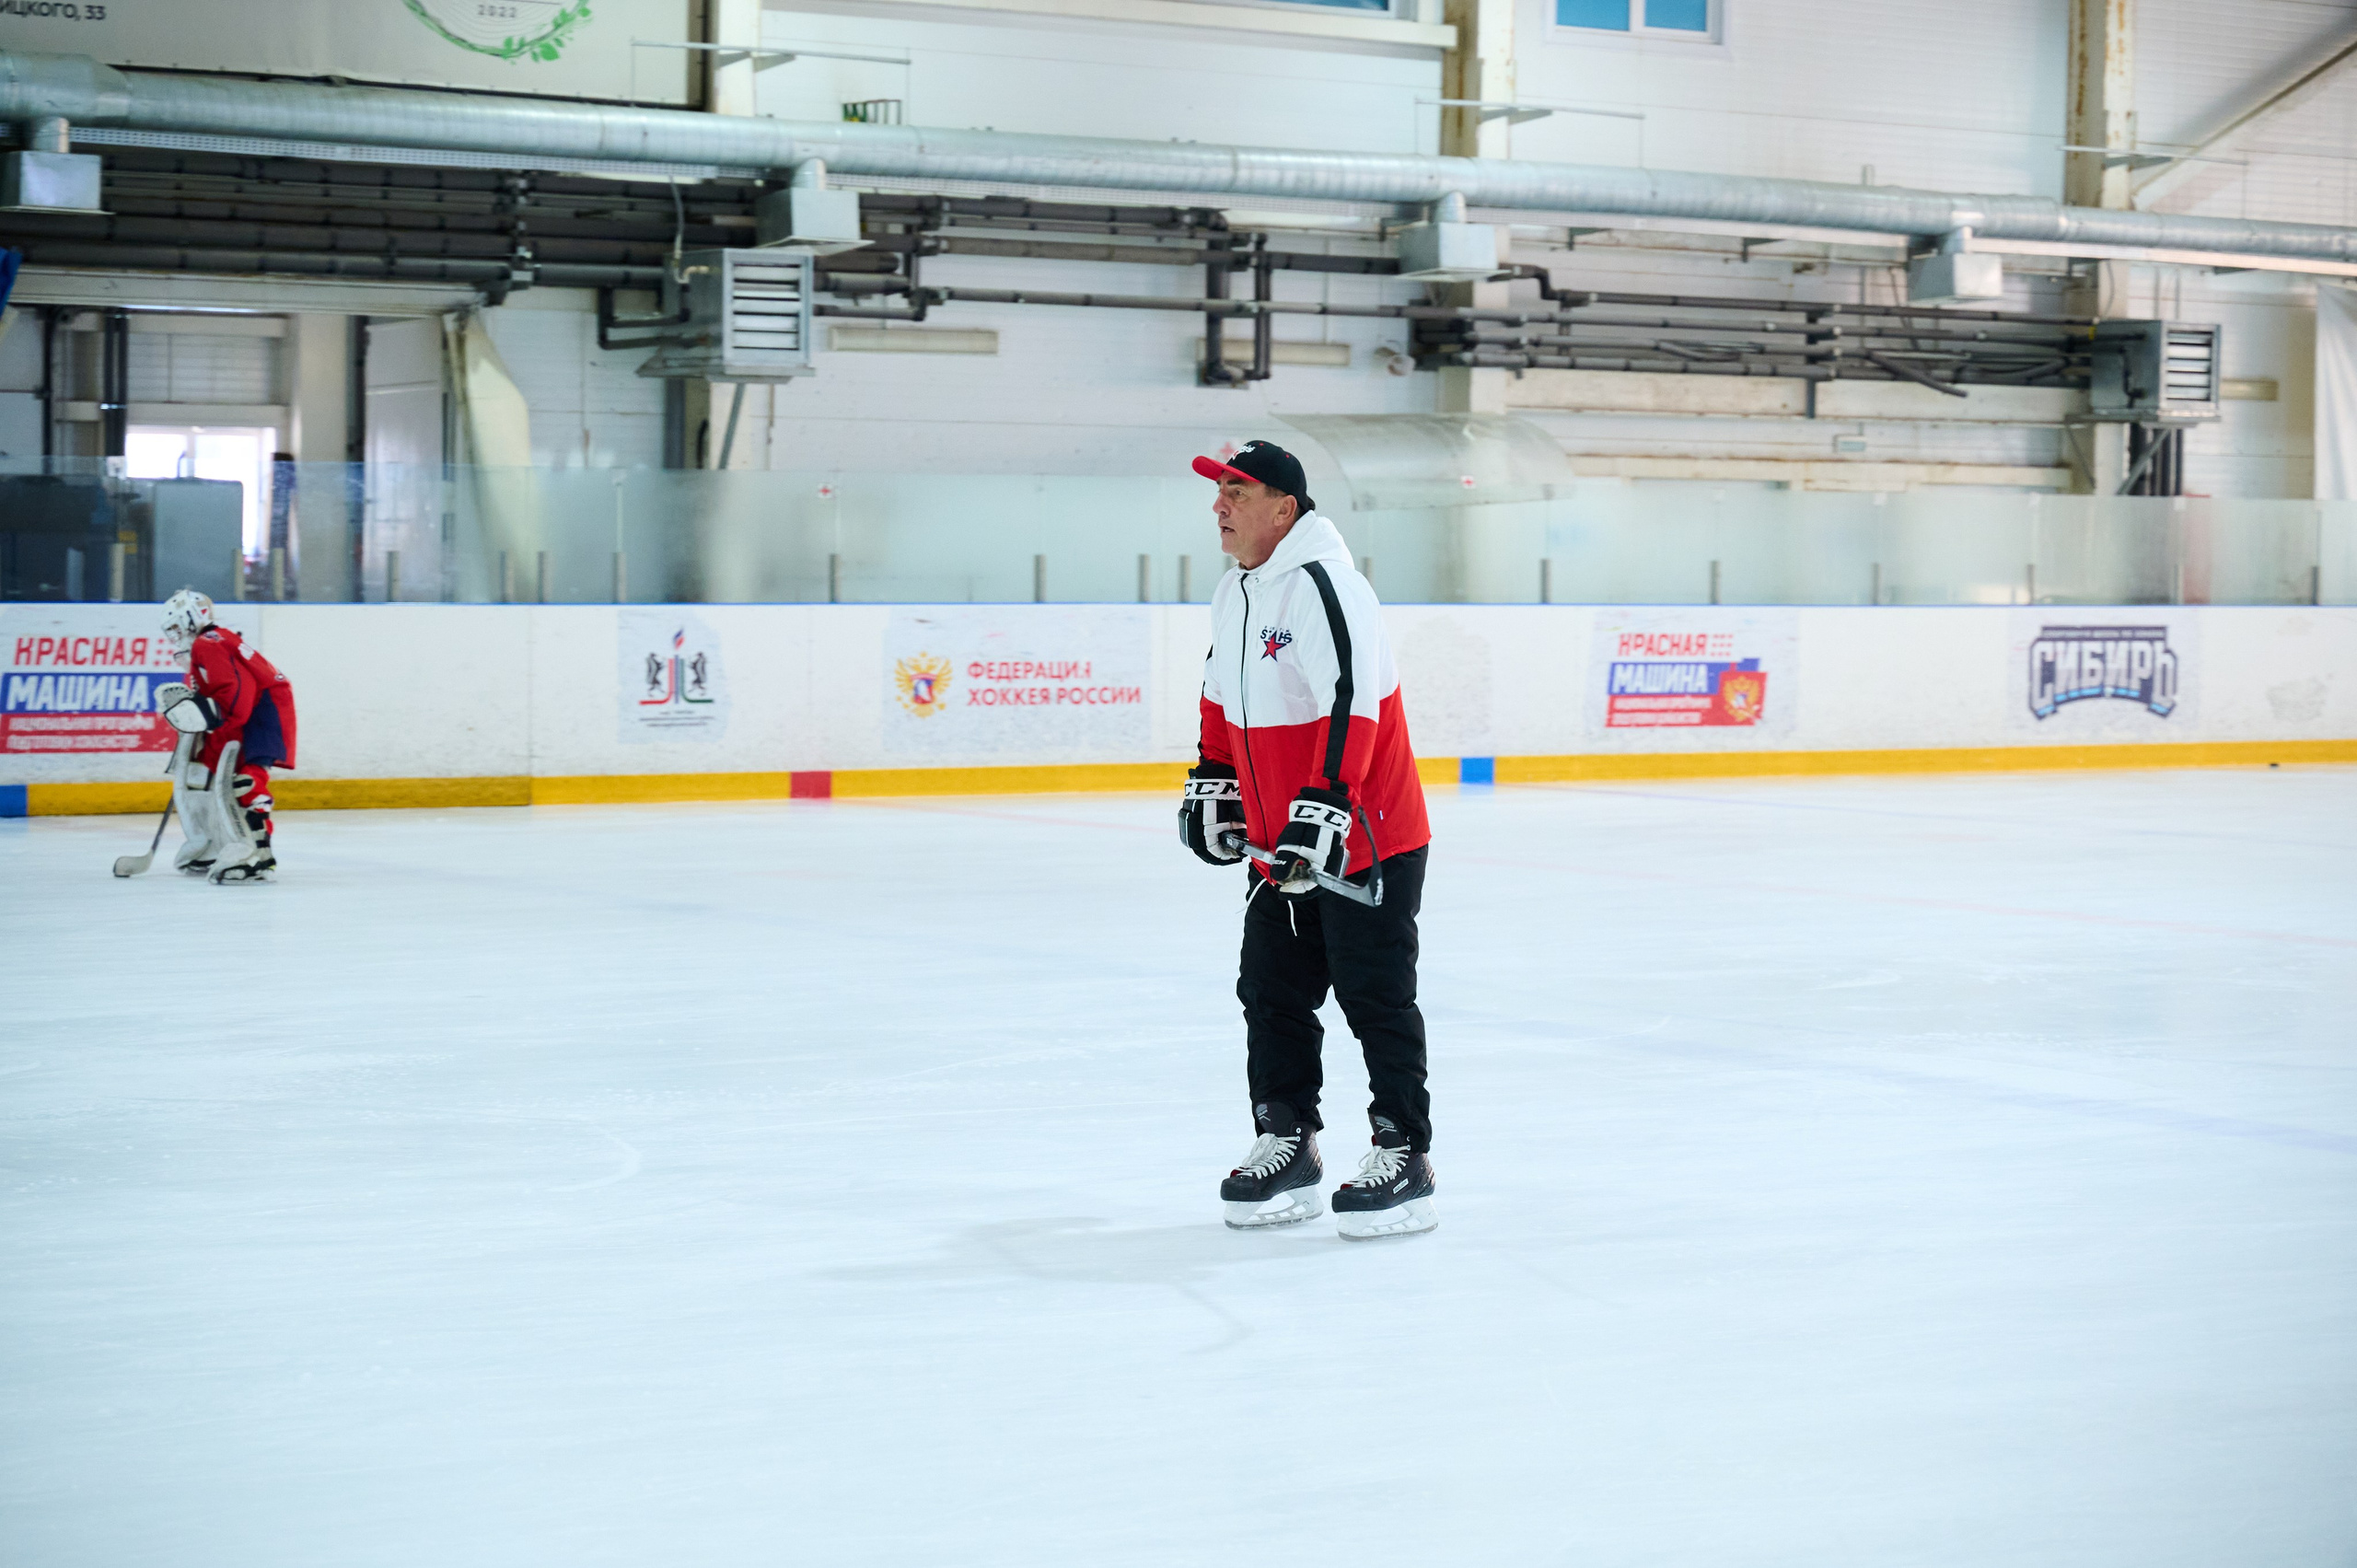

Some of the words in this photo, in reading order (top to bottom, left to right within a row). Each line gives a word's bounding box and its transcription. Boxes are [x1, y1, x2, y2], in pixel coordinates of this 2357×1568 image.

[85, 5, 106, 20] 33
[478, 4, 517, 17] 2022
[14, 637, 149, 666] КРАСНАЯ
[1618, 633, 1708, 656] КРАСНАЯ
[1612, 663, 1708, 693] МАШИНА
[2029, 637, 2177, 720] СИБИРЬ
[6, 675, 150, 711] МАШИНА
[968, 688, 1051, 706] ХОККЕЯ
[1057, 687, 1141, 705] РОССИИ
[1294, 805, 1352, 831] CC
